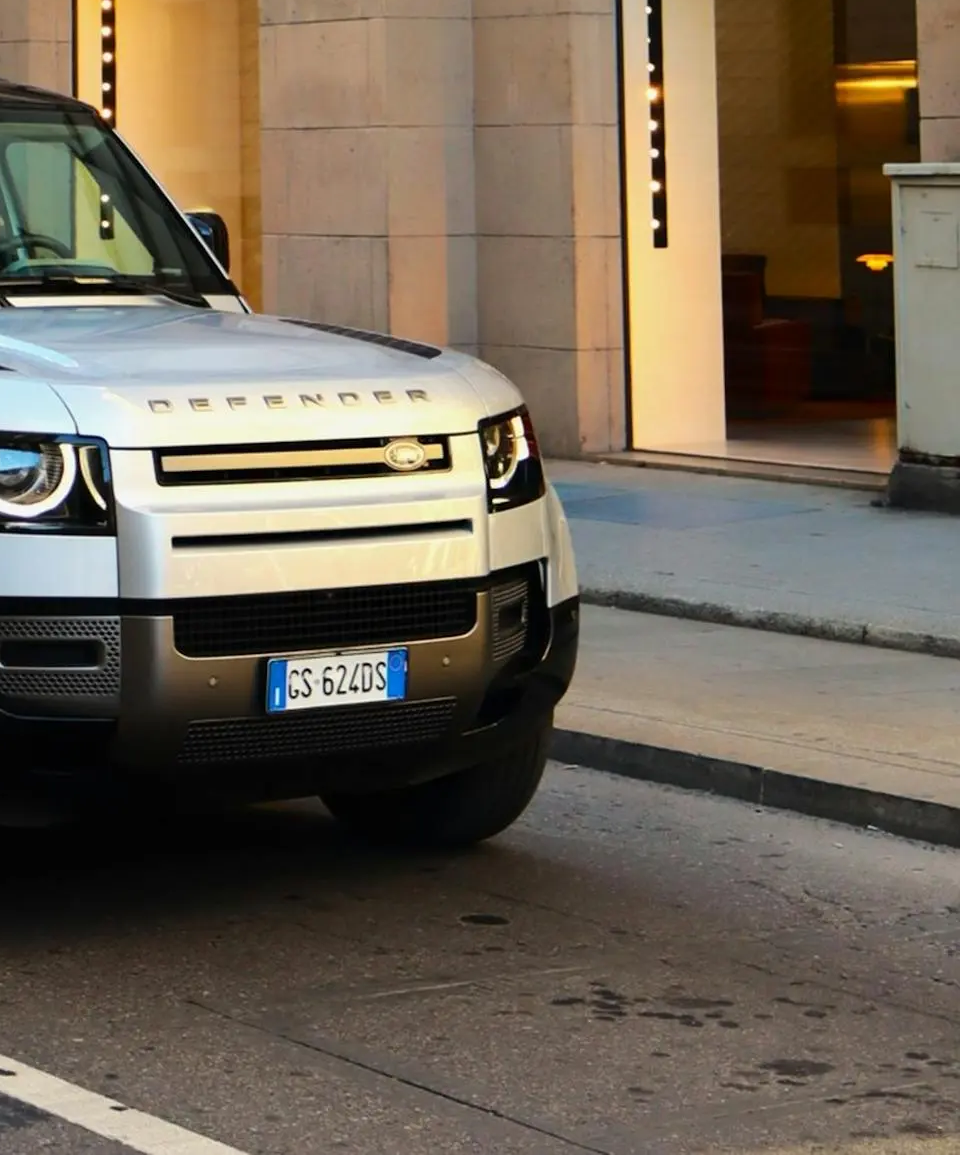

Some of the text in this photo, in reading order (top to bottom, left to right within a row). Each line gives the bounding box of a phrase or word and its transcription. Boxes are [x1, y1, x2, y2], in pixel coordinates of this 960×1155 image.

[148, 389, 433, 414] DEFENDER
[288, 661, 387, 700] GS 624DS
